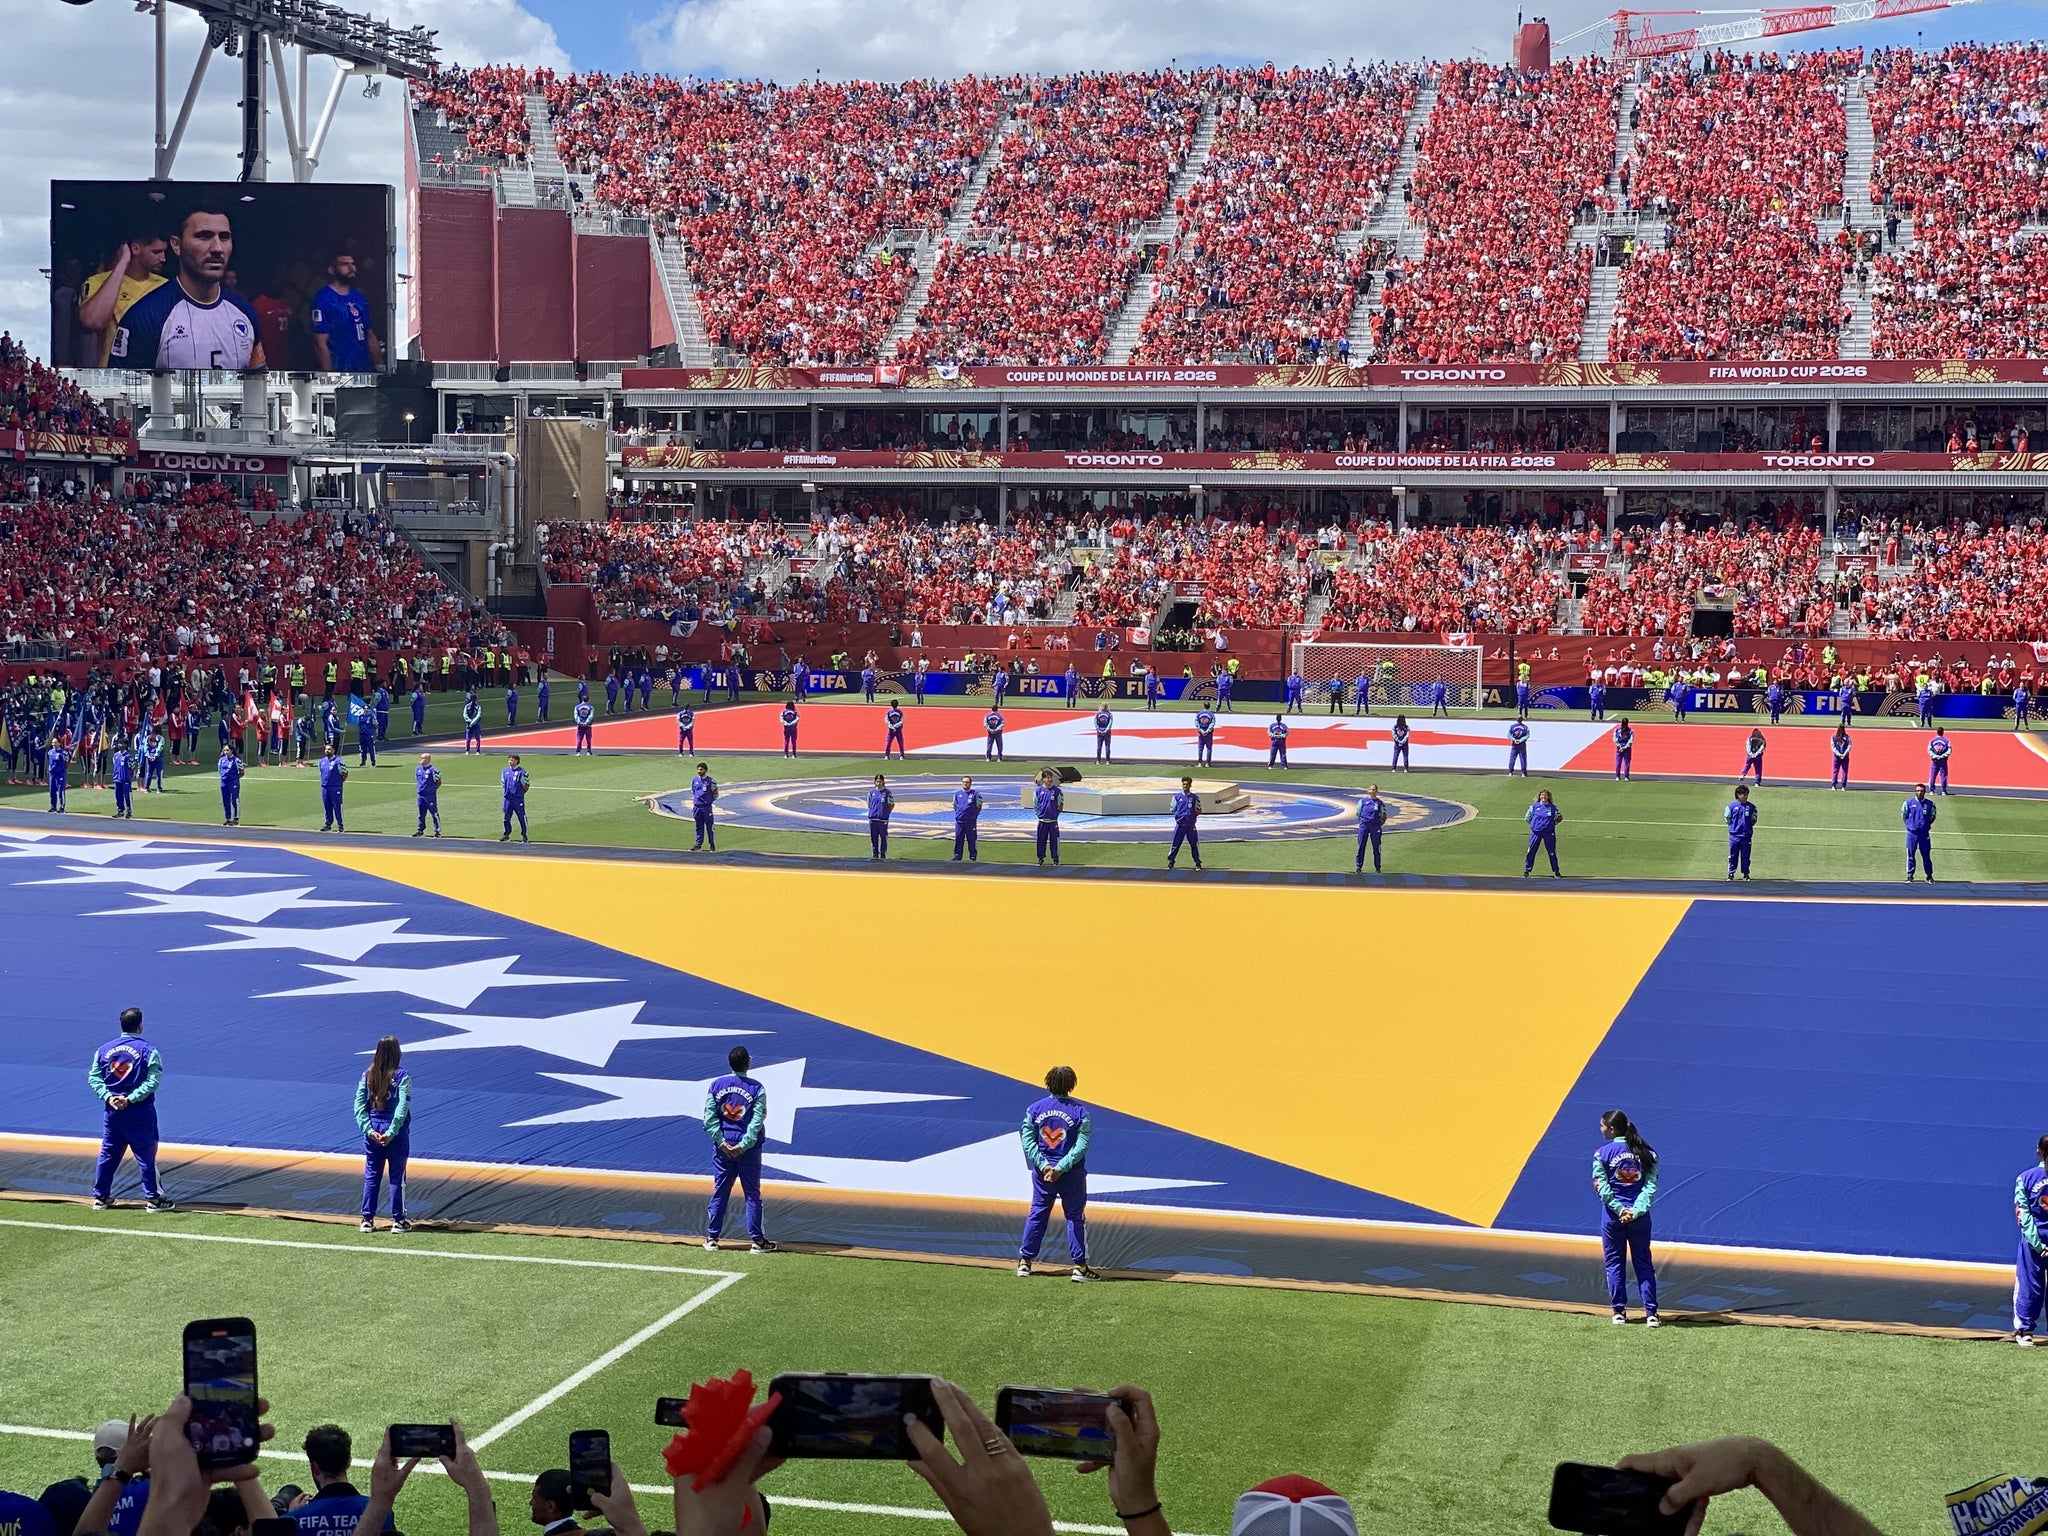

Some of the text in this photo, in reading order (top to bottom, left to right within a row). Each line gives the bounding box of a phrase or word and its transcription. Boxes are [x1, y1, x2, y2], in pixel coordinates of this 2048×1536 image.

[819, 373, 874, 383] #FIFAWorldCup
[1006, 370, 1217, 382] COUPE DU MONDE DE LA FIFA 2026
[1401, 370, 1506, 381] TORONTO
[1710, 366, 1868, 378] FIFA WORLD CUP 2026
[150, 454, 265, 471] TORONTO
[783, 455, 837, 466] #FIFAWorldCup
[1064, 455, 1164, 466] TORONTO
[1335, 456, 1556, 467] COUPE DU MONDE DE LA FIFA 2026
[1763, 456, 1875, 467] TORONTO
[810, 674, 848, 689] FIFA
[1020, 679, 1059, 693] FIFA
[1695, 693, 1739, 709] FIFA
[104, 1044, 140, 1060] VOLUNTEER
[715, 1086, 753, 1103] VOLUNTEER
[1035, 1110, 1075, 1128] VOLUNTEER
[299, 1515, 359, 1529] FIFA TEA
